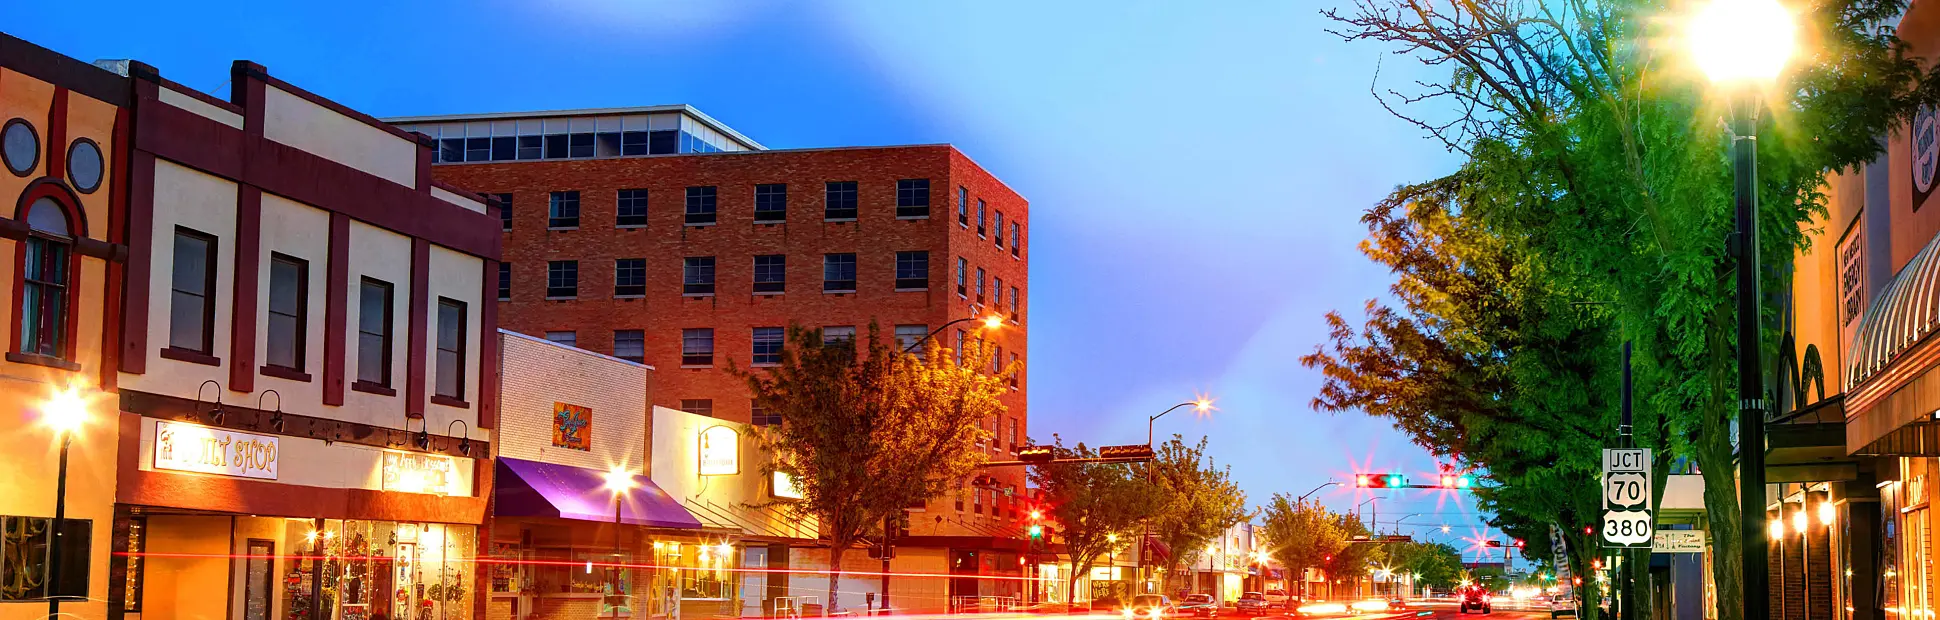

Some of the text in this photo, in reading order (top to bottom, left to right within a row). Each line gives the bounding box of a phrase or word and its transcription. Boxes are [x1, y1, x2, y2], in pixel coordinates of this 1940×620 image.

[234, 439, 276, 474] SHOP
[1612, 453, 1641, 468] JCT
[1614, 481, 1640, 500] 70
[1607, 520, 1647, 536] 380
